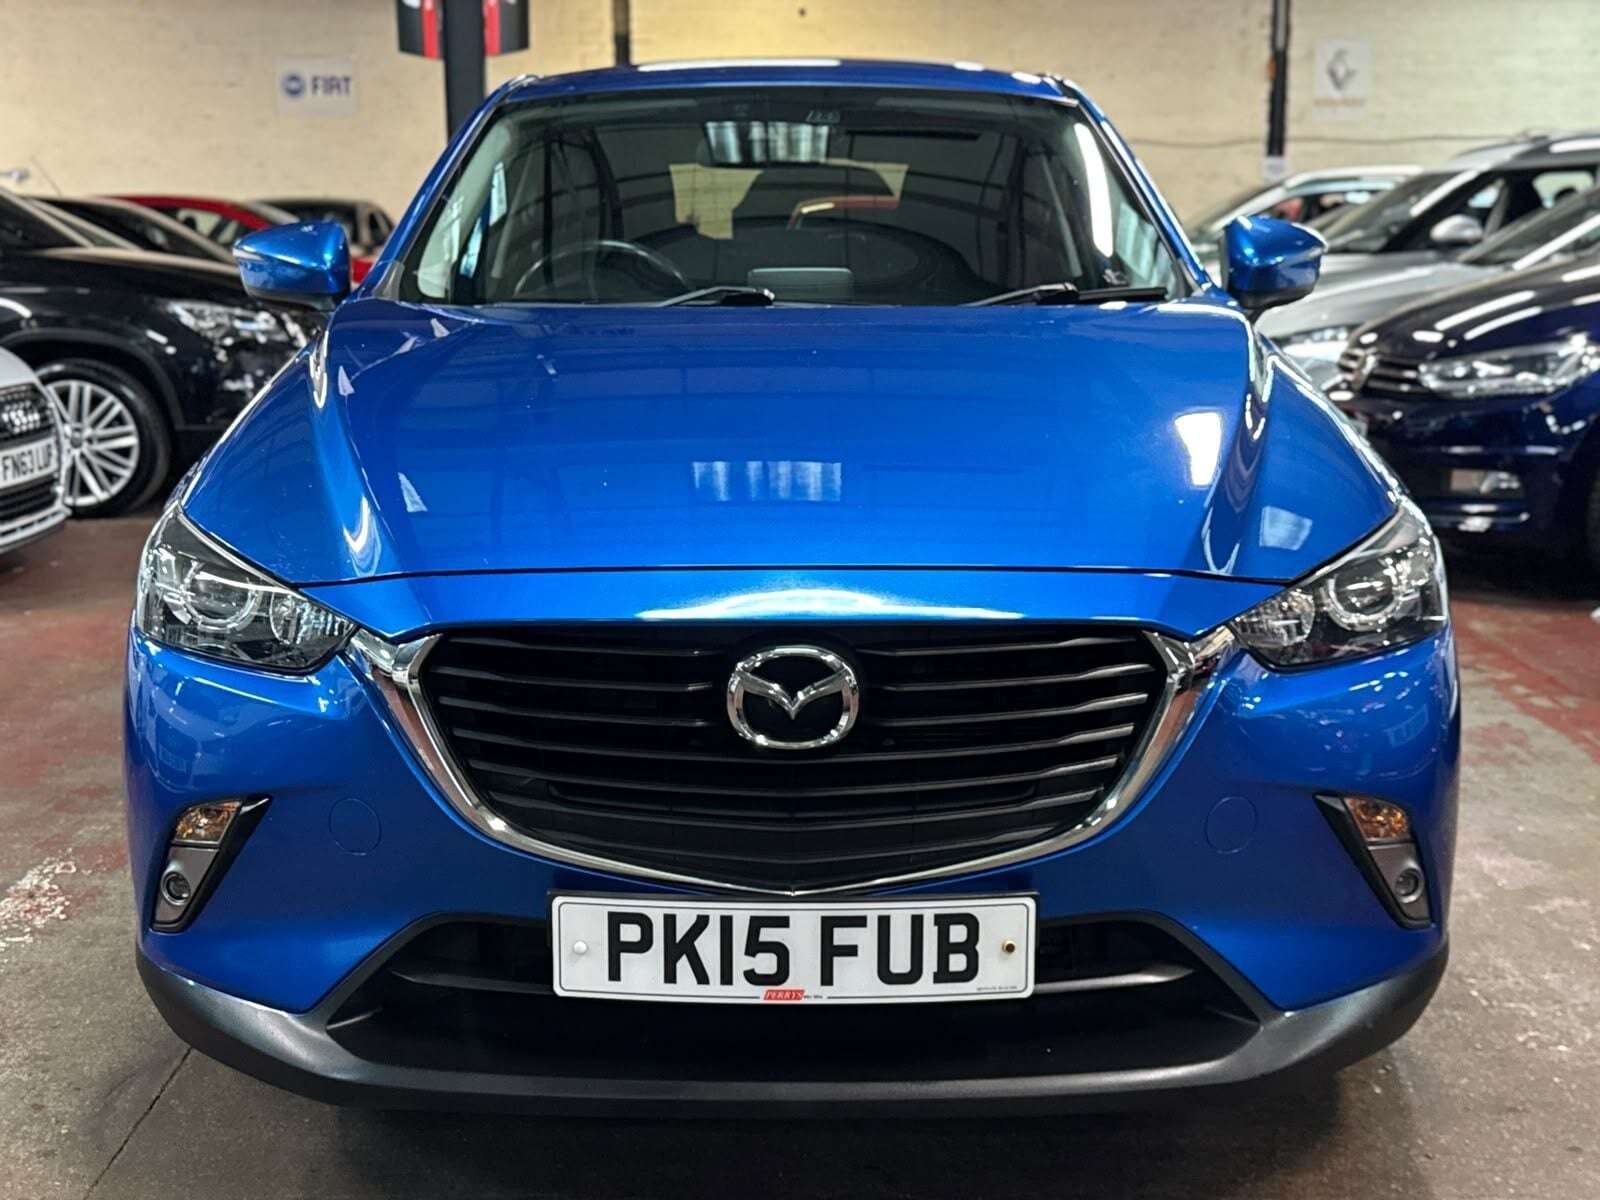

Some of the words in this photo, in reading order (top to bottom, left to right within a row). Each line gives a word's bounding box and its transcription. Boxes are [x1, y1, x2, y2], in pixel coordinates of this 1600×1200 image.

[312, 75, 351, 96] FIAT
[2, 450, 34, 481] FN63
[607, 911, 790, 986] PK15
[820, 912, 980, 986] FUB
